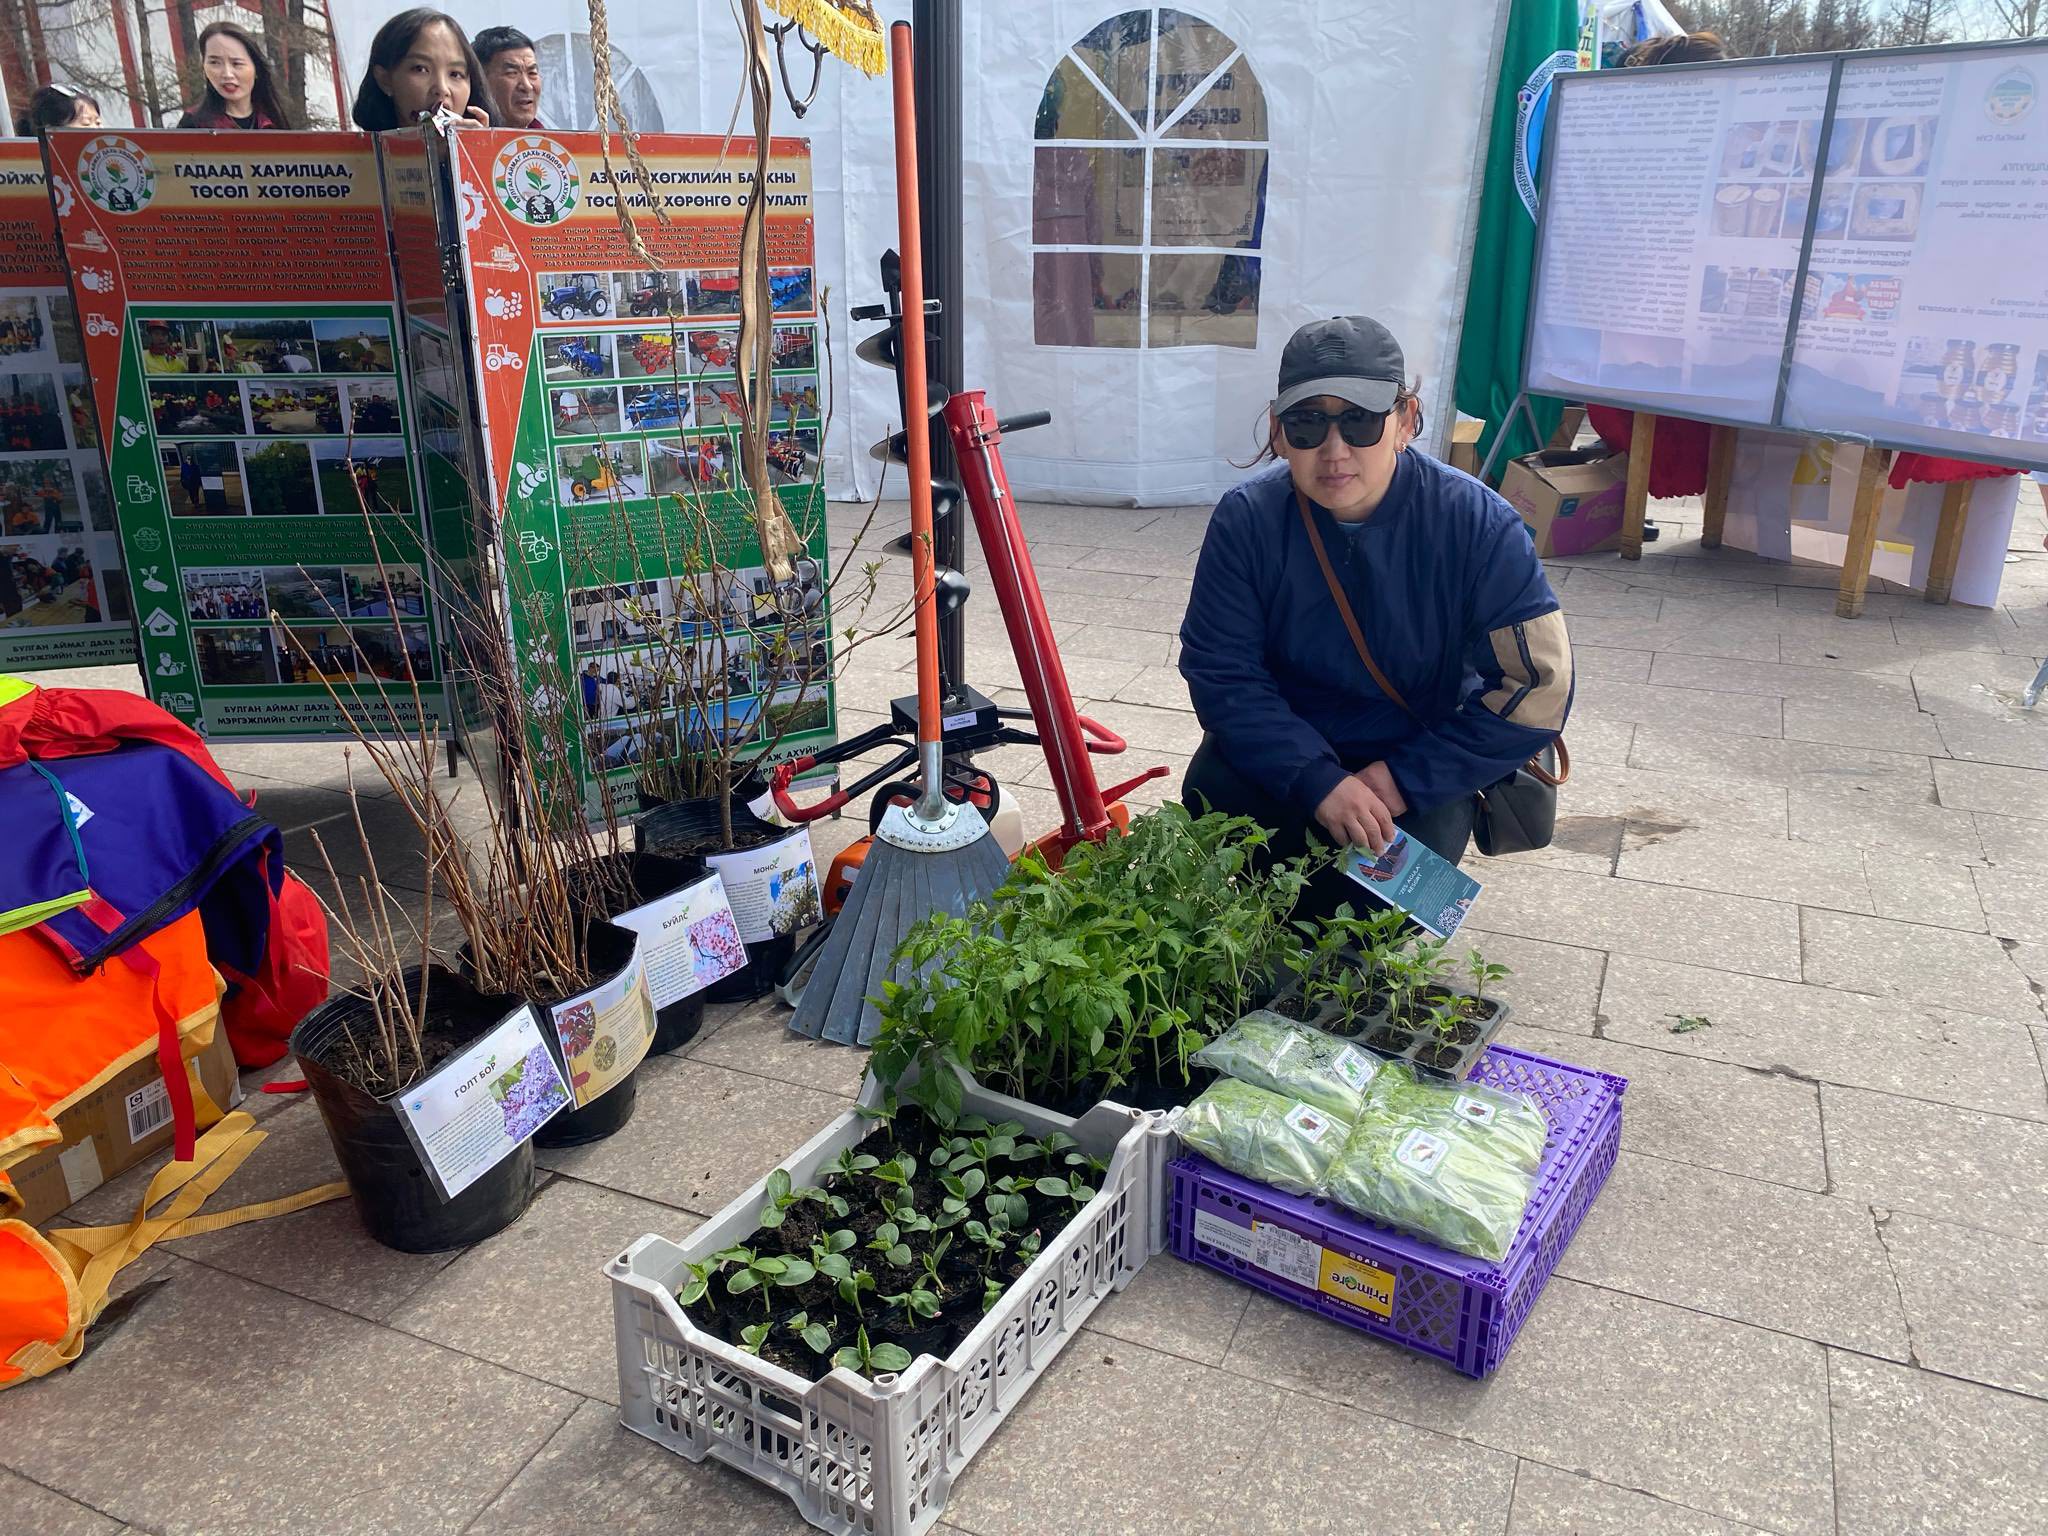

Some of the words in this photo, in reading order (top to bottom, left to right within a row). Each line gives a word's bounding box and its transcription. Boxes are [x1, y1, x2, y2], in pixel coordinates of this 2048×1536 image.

[174, 163, 244, 179] ГАДААД
[251, 163, 354, 179] ХАРИЛЦАА,
[650, 171, 732, 184] ХӨГЖЛИЙН
[738, 172, 796, 184] БАКНЫ
[190, 184, 249, 199] ТӨСӨЛ
[257, 184, 352, 199] ХӨТӨЛБӨР
[664, 194, 732, 207] ХӨРӨНГӨ
[224, 704, 262, 713] БУЛГАН
[266, 703, 300, 713] АЙМАГ
[304, 703, 330, 712] ДАХЬ
[217, 715, 286, 725] МЭРГЭЖЛИЙН
[290, 714, 330, 724] СУРГАЛТ
[786, 745, 820, 758] АХУЙН
[662, 911, 689, 930] БУЙЛС
[453, 1076, 479, 1098] ГОЛТ
[479, 1061, 498, 1080] БОР
